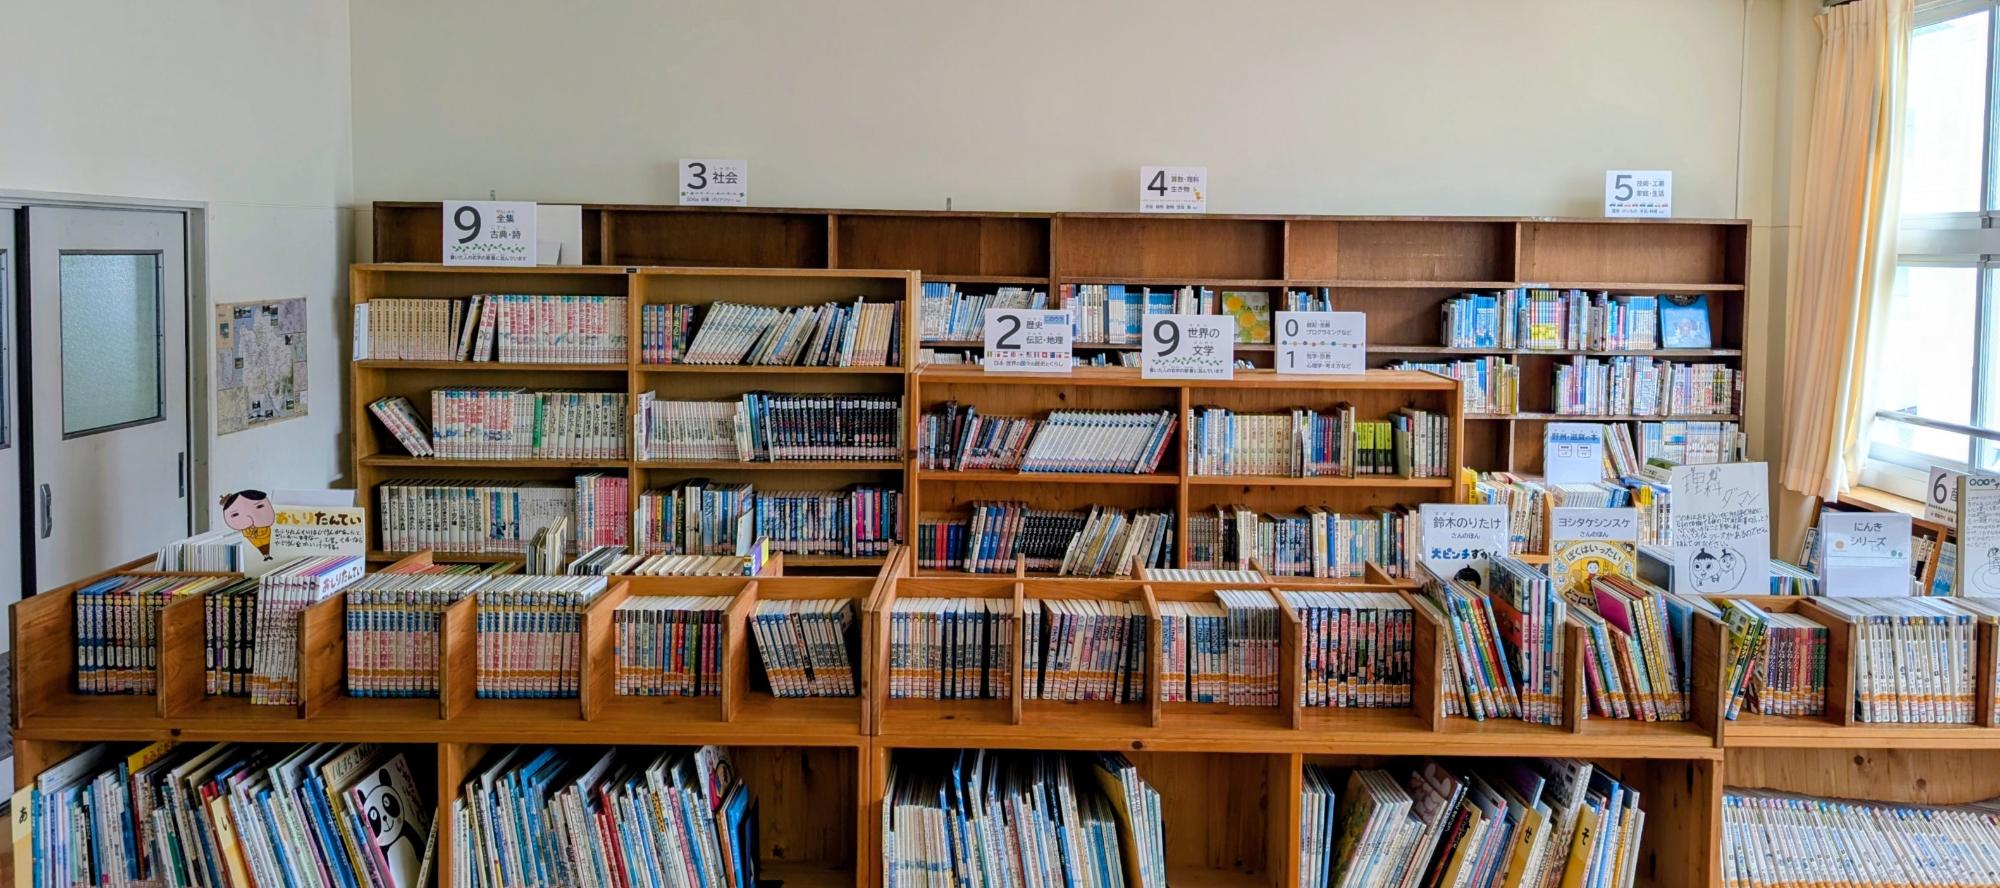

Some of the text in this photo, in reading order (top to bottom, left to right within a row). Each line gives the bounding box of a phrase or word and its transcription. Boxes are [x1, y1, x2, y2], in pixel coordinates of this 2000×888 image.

[687, 162, 707, 190] 3
[712, 171, 738, 184] 社会
[1147, 170, 1168, 197] 4
[1614, 174, 1633, 202] 5
[454, 206, 481, 245] 9
[496, 214, 514, 224] 全集
[490, 230, 521, 240] 古典・詩
[996, 315, 1021, 350] 2
[1026, 320, 1043, 330] 歴史
[1187, 327, 1220, 339] 世界の
[1285, 319, 1299, 337] 0
[1026, 335, 1064, 345] 伝記・地理
[1153, 320, 1180, 358] 9
[1192, 345, 1215, 356] 文学
[1286, 350, 1295, 369] 1
[1681, 469, 1722, 497] 理科
[1933, 472, 1948, 504] 6
[275, 510, 362, 526] おしりたんてい
[1433, 516, 1502, 529] 鈴木のりたけ
[1558, 517, 1631, 528] ヨシタケシンスケ
[1854, 522, 1883, 532] にんき
[1450, 532, 1481, 540] さんのほん
[1850, 536, 1887, 547] シリーズ
[1431, 547, 1502, 561] 大ピンチずかん
[1565, 543, 1623, 563] ぼくはいったい
[322, 566, 364, 593] おしりたんてい
[18, 806, 28, 825] あ
[1524, 826, 1533, 845] せ
[1581, 827, 1590, 846] そ
